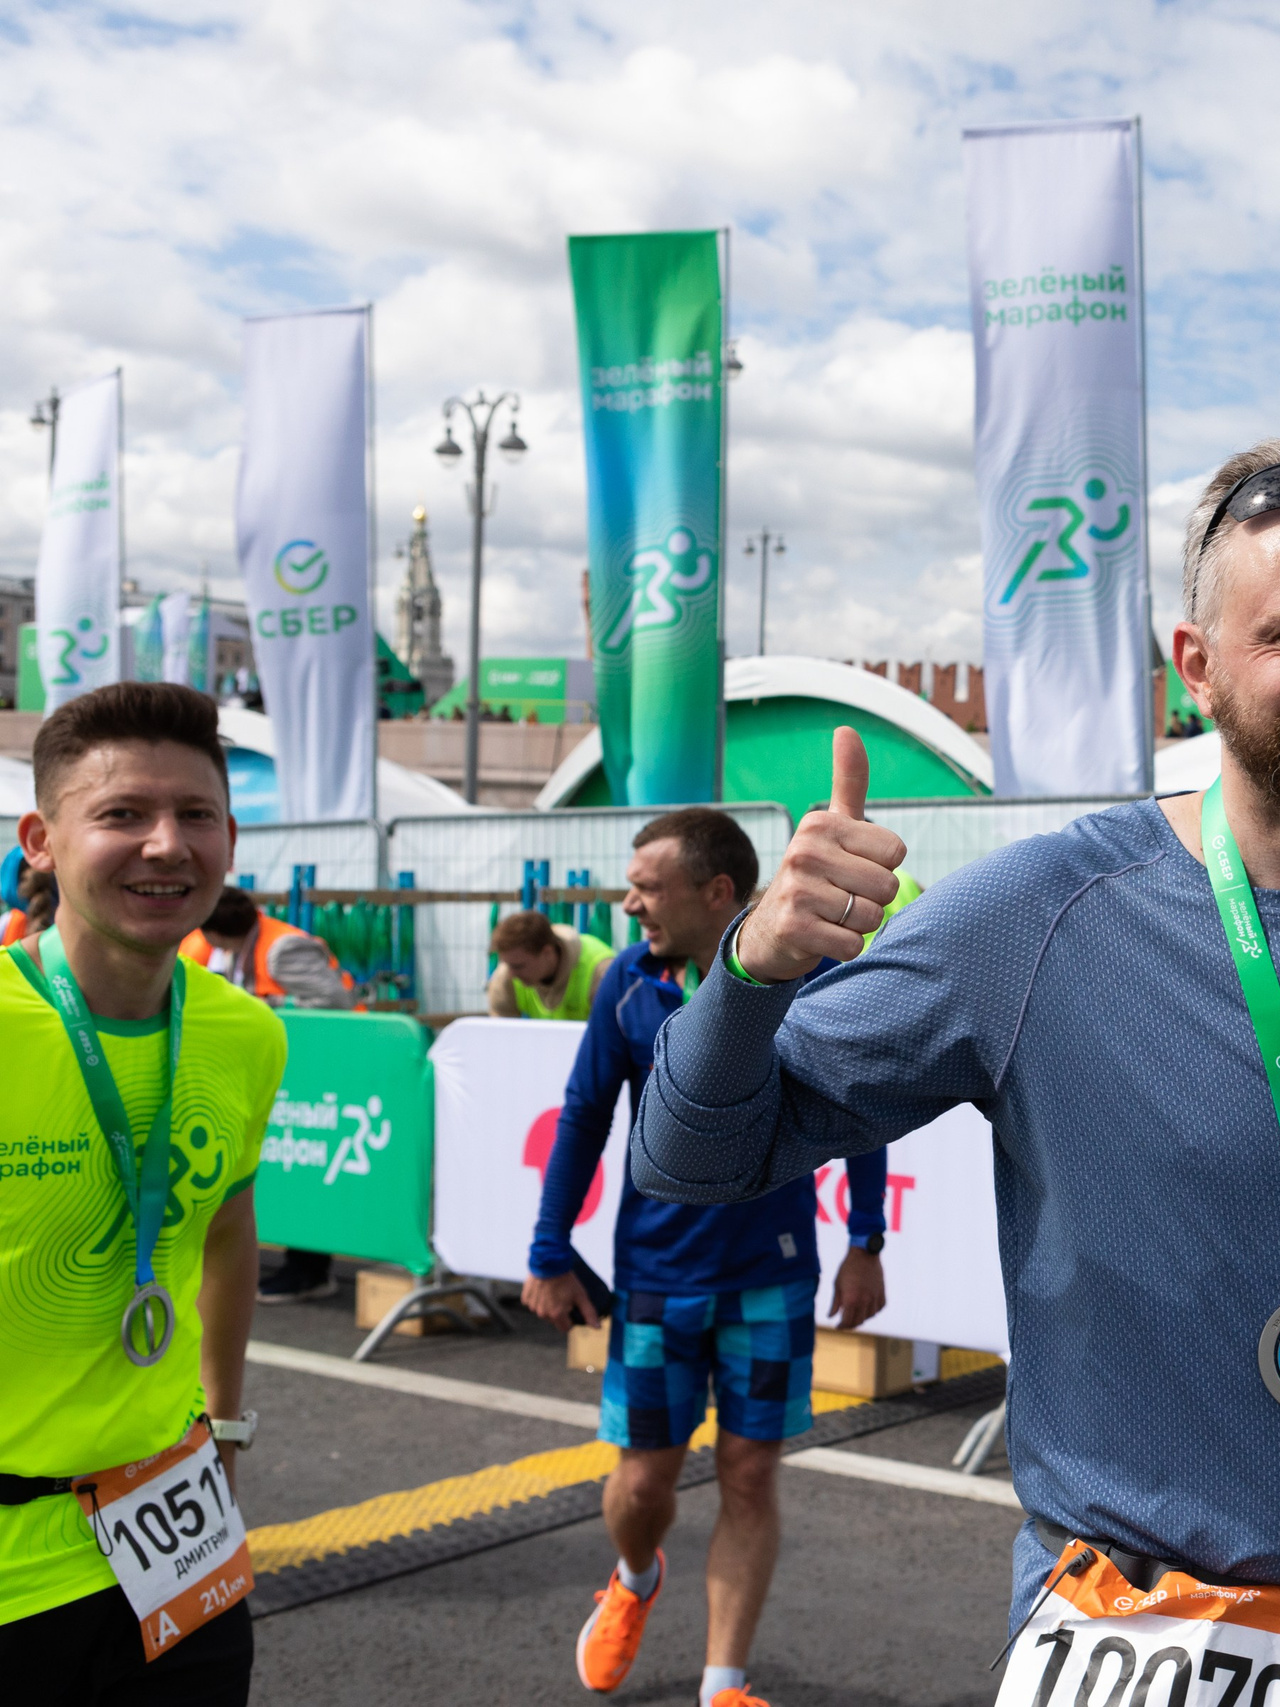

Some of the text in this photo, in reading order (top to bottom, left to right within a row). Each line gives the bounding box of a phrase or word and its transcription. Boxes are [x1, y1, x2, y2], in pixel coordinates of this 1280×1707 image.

[983, 264, 1126, 300] зелёный
[984, 294, 1127, 329] марафон
[256, 604, 358, 639] СБЕР
[1217, 850, 1234, 881] СБЕР
[1229, 898, 1245, 938] марафон
[1238, 901, 1255, 940] зелёный
[268, 1089, 338, 1130] ёный
[260, 1127, 328, 1172] афон
